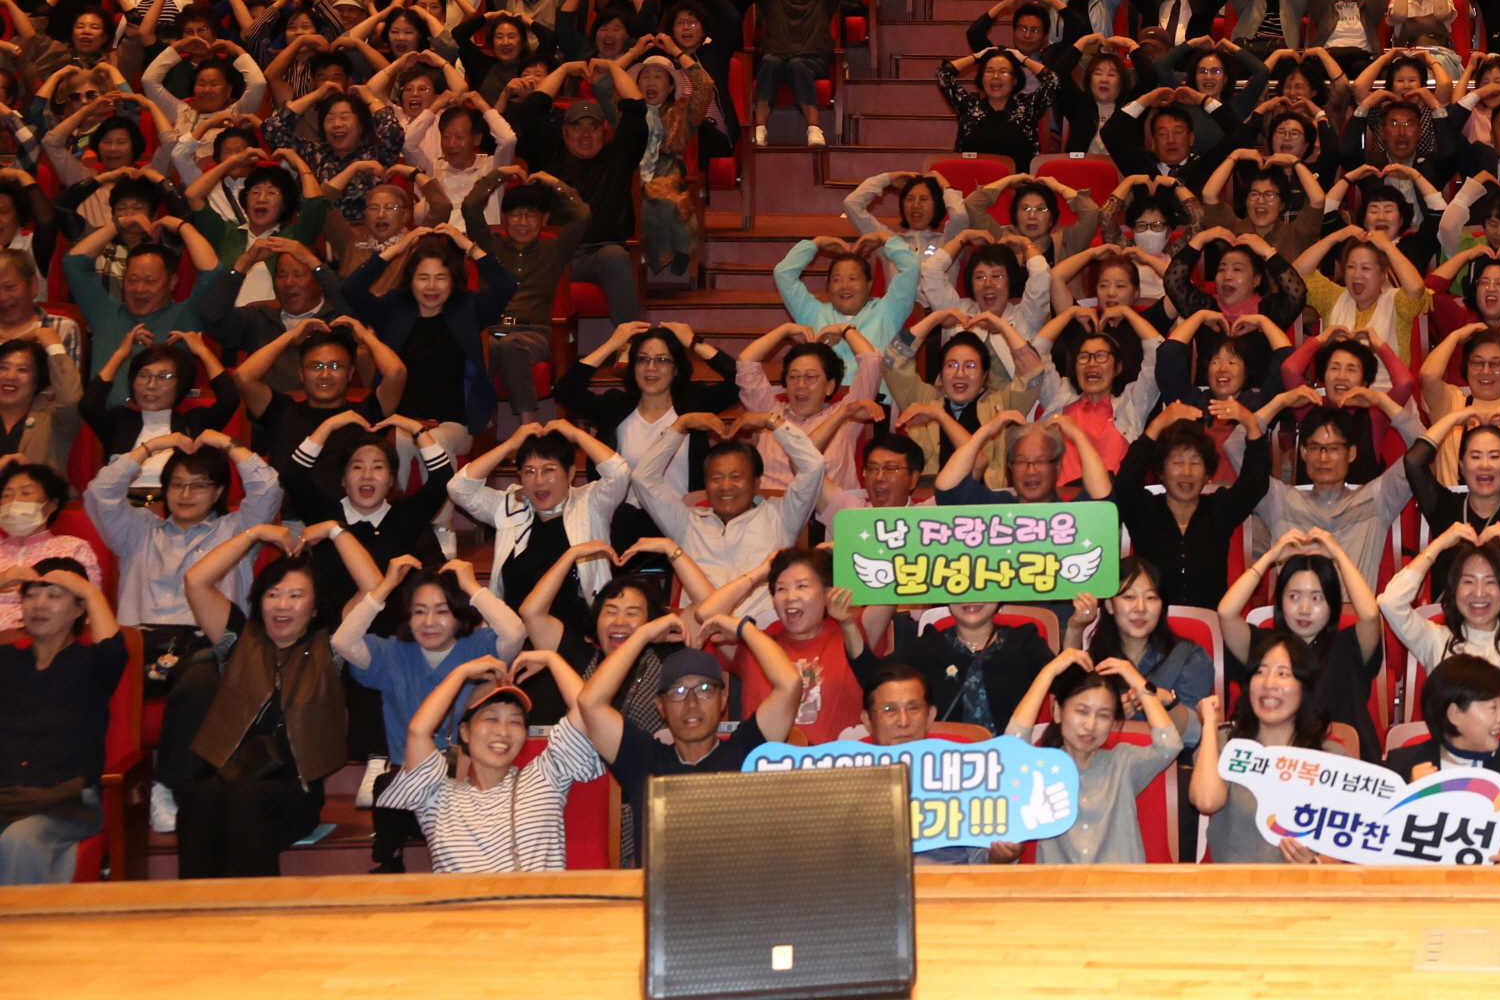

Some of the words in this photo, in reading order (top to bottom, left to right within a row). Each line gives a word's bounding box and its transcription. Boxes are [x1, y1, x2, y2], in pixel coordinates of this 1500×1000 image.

[875, 518, 909, 549] 난
[918, 511, 1077, 548] 자랑스러운
[892, 551, 1061, 596] 보성사람
[921, 748, 1005, 794] 내가
[1228, 748, 1270, 775] 꿈과
[1275, 755, 1339, 787] 행복이
[1341, 772, 1396, 800] 넘치는
[1293, 803, 1391, 853] 희망찬
[1393, 811, 1497, 866] 보성
